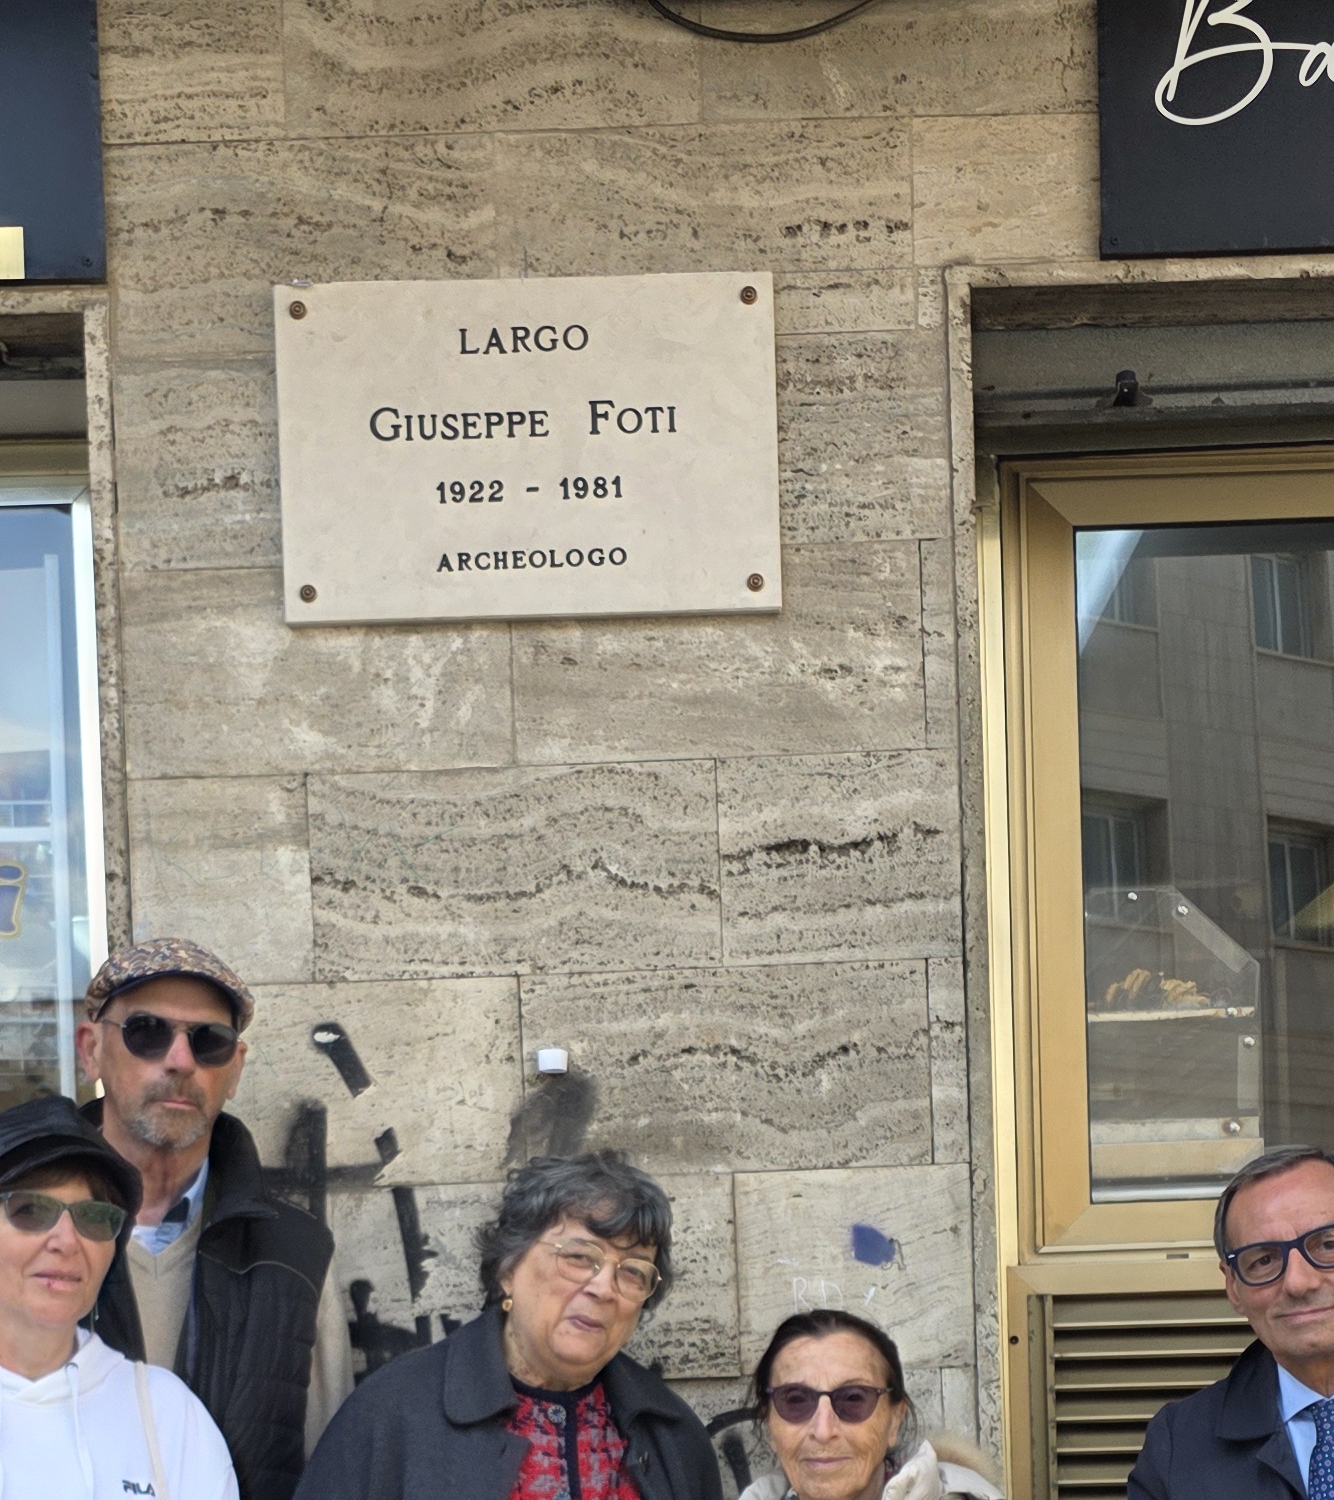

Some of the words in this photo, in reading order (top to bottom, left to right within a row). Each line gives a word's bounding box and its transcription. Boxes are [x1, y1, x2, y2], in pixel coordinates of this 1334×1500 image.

[459, 324, 590, 355] LARGO
[436, 479, 504, 504] 1922
[558, 475, 624, 501] 1981
[436, 546, 628, 573] ARCHEOLOGO
[122, 1480, 156, 1497] FILA
